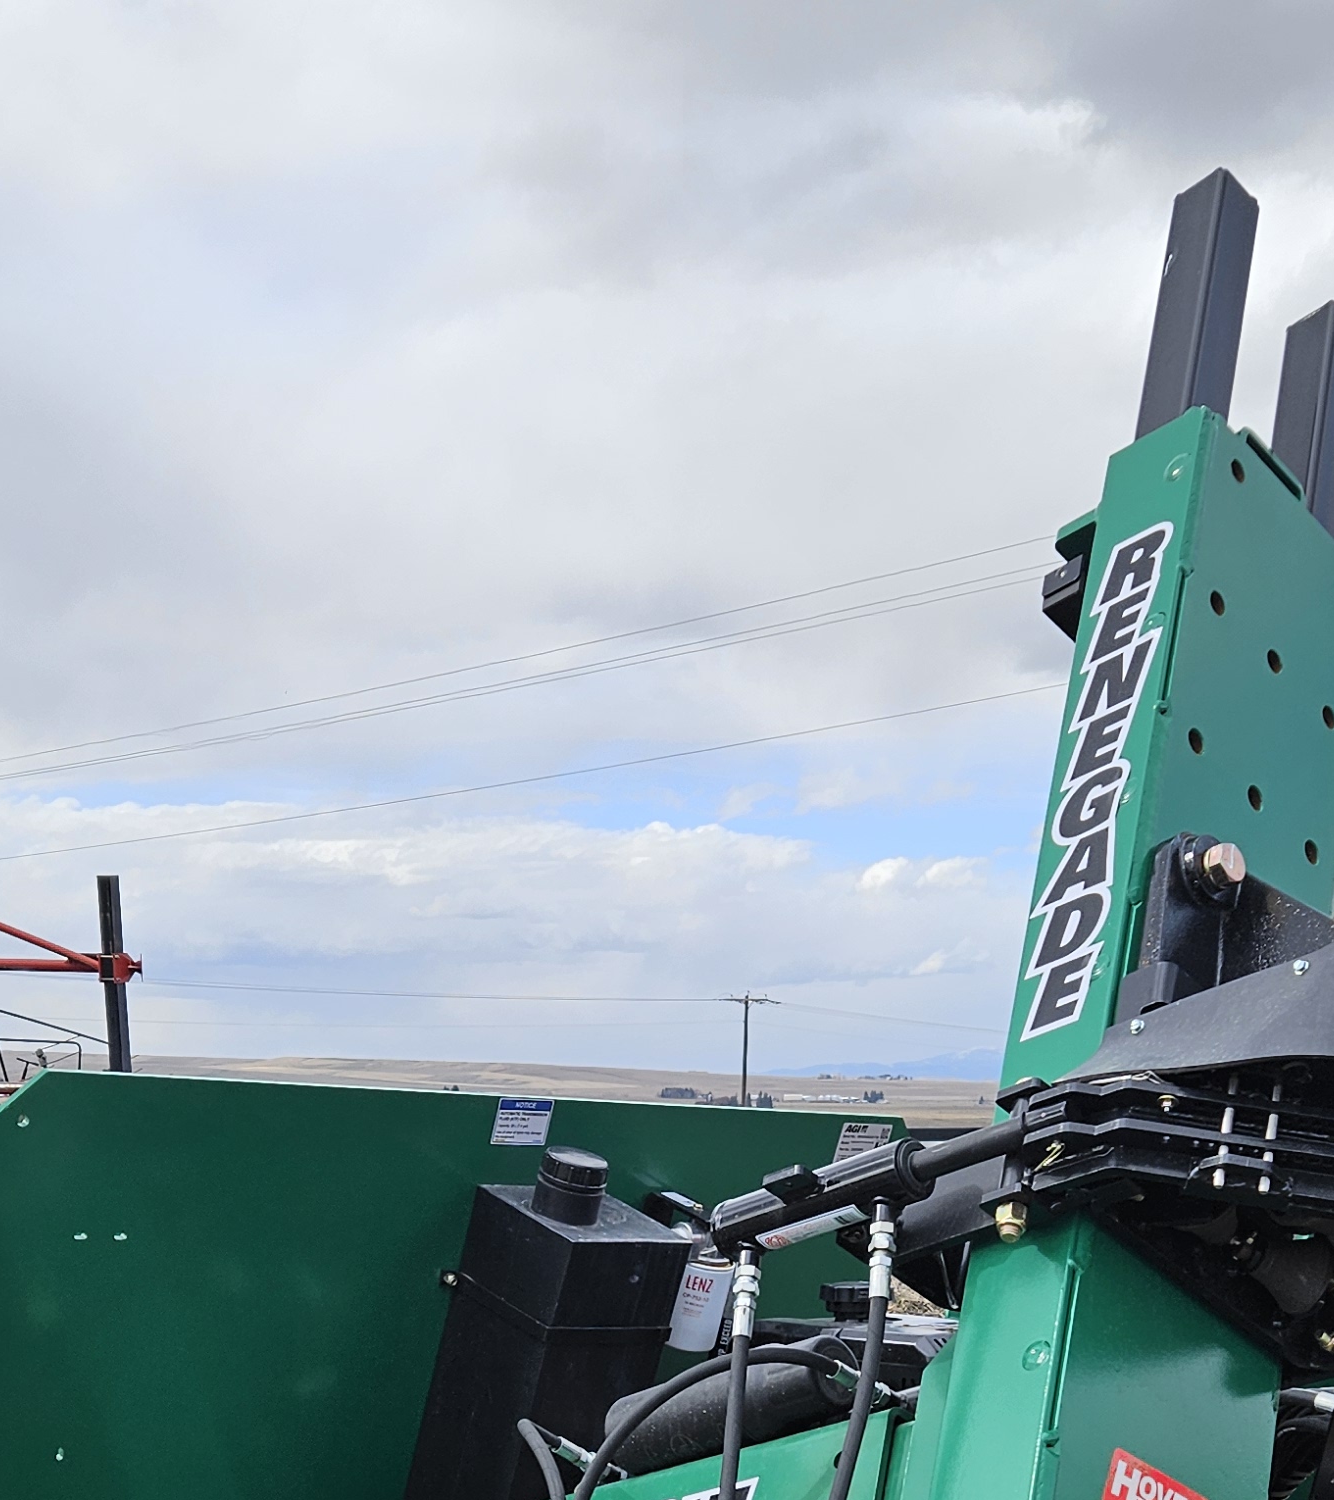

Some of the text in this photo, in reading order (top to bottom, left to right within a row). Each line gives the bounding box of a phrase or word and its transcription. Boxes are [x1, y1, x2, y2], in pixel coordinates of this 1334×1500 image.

[1027, 526, 1167, 1033] RENEGADE
[845, 1125, 861, 1133] AGI
[685, 1274, 714, 1293] LENZ
